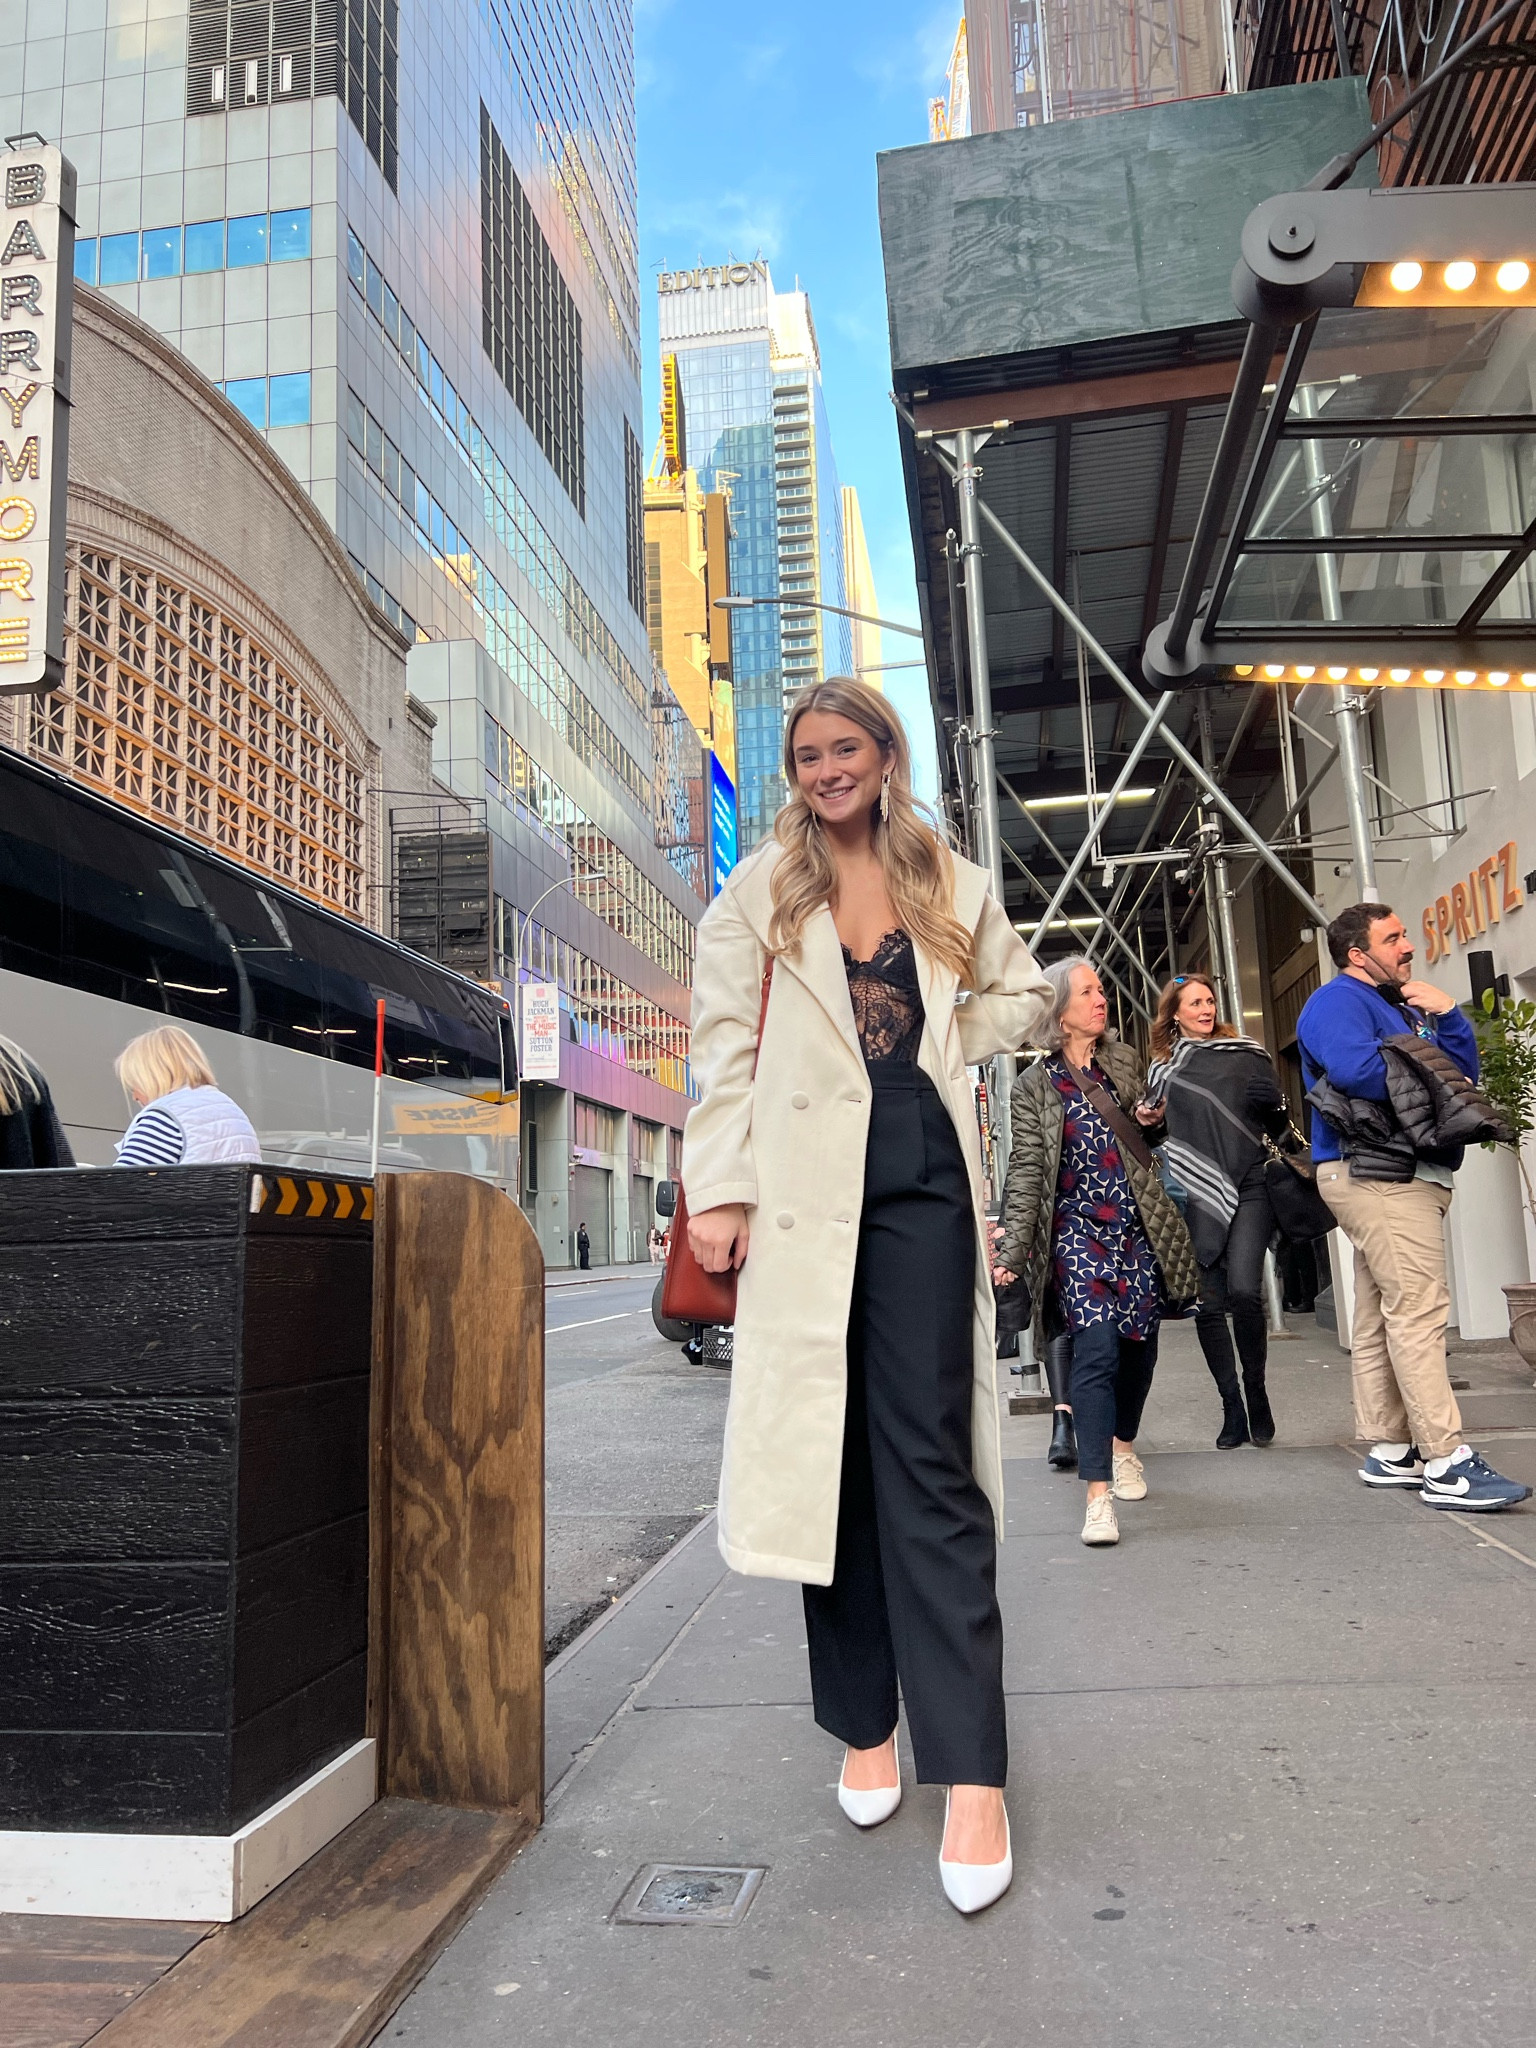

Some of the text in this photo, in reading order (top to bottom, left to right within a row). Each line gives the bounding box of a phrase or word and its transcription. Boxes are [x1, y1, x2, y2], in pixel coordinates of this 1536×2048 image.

[657, 260, 769, 295] EDITION
[0, 163, 47, 663] BARRYMORE
[1422, 841, 1523, 965] SPRITZ
[532, 1000, 549, 1008] HUGH
[527, 1007, 555, 1015] JACKMAN
[526, 1023, 557, 1031] THE MUSIC
[530, 1044, 552, 1052] FOSTER
